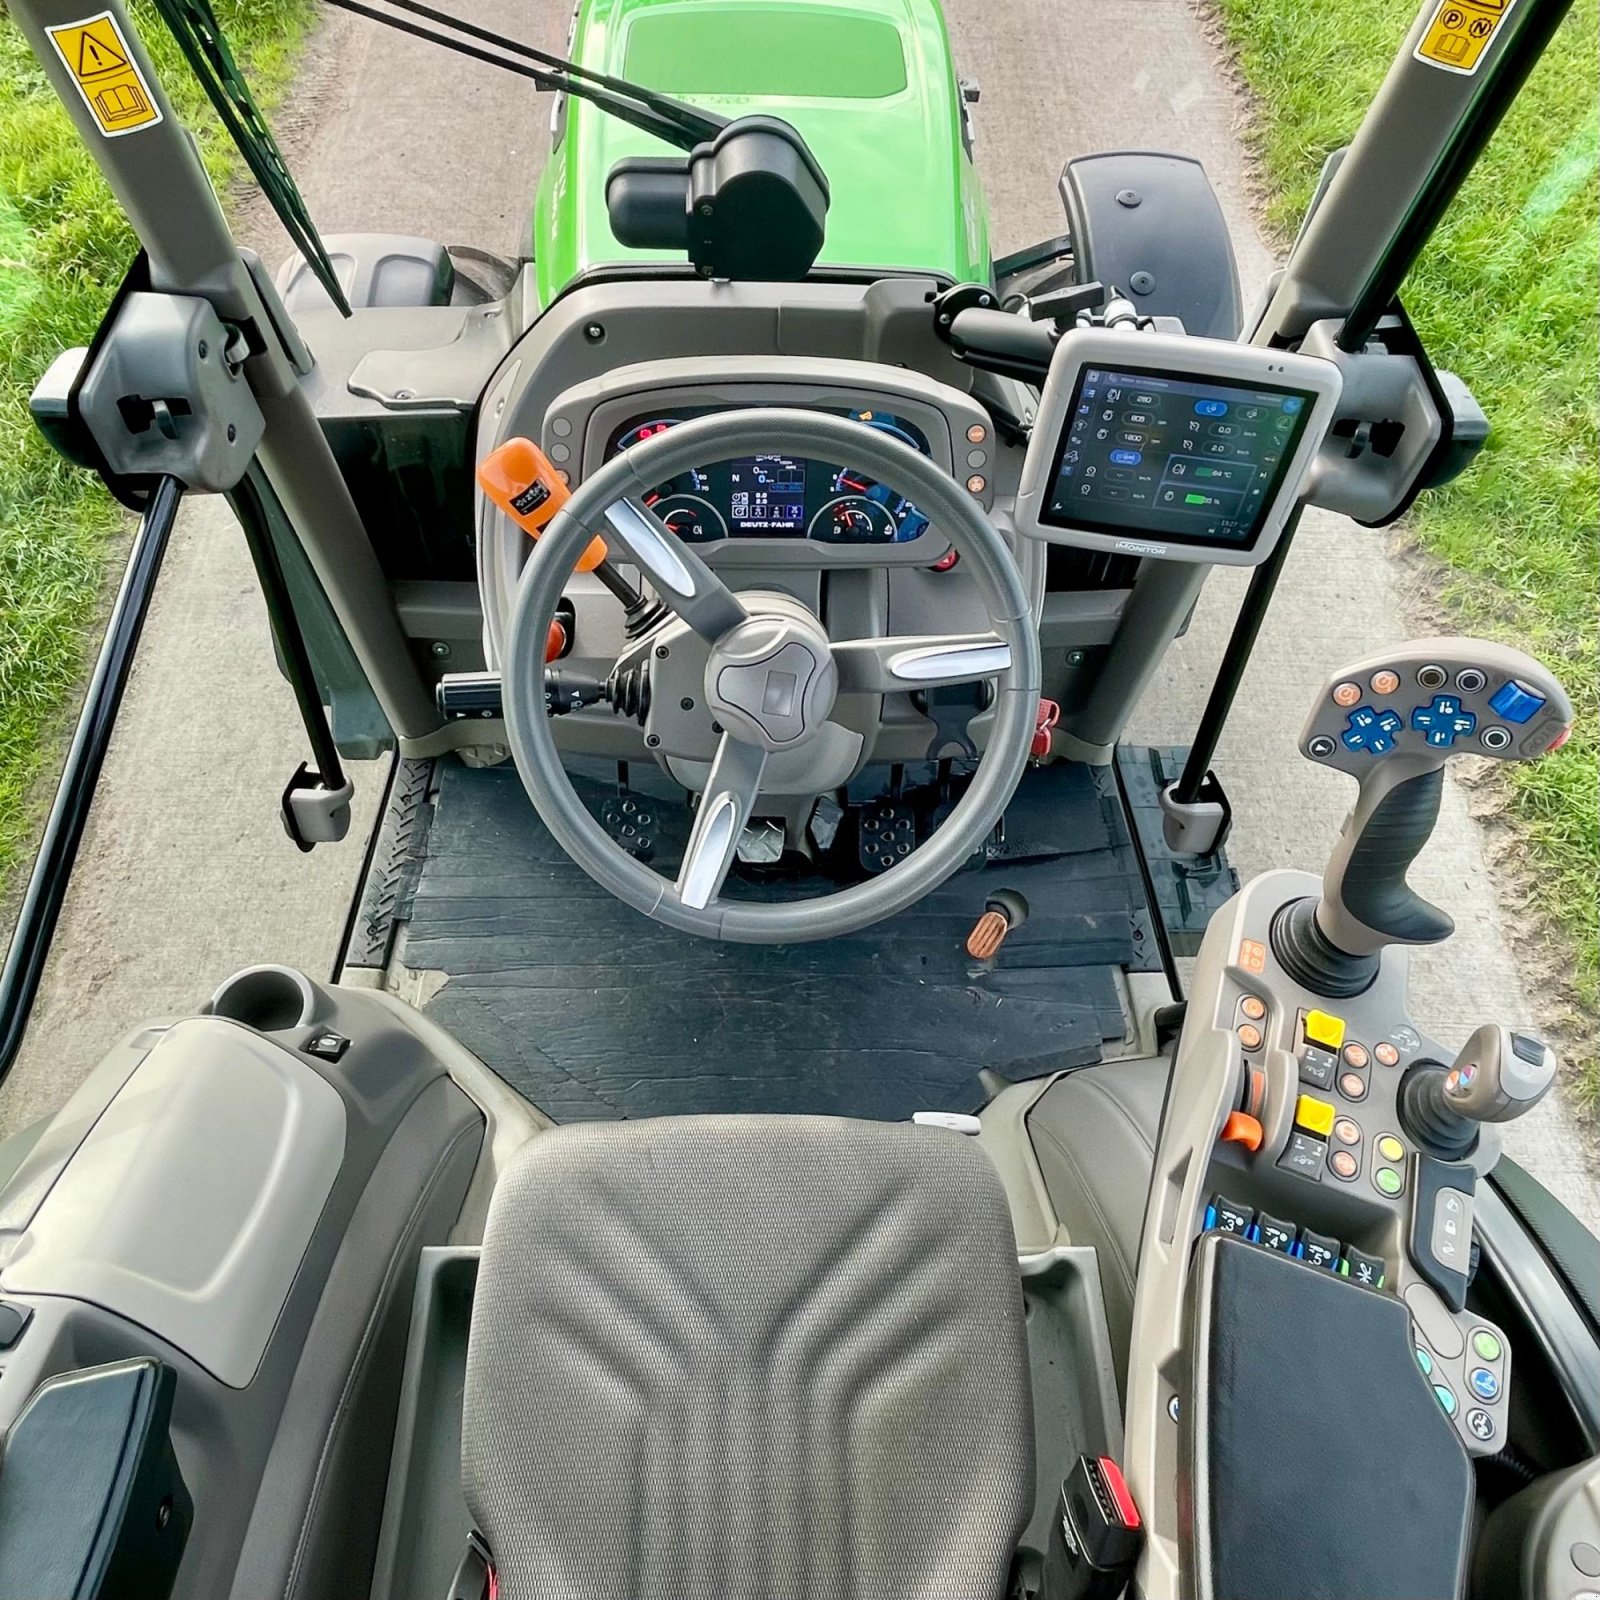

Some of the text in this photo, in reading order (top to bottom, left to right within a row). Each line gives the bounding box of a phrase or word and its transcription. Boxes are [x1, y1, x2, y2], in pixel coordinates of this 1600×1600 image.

[1446, 12, 1459, 25] P
[1473, 22, 1487, 34] N
[1218, 426, 1232, 434] 0.0
[731, 474, 740, 483] N
[1225, 1219, 1235, 1232] 3
[1269, 1236, 1279, 1249] 4
[1313, 1252, 1323, 1266] 5
